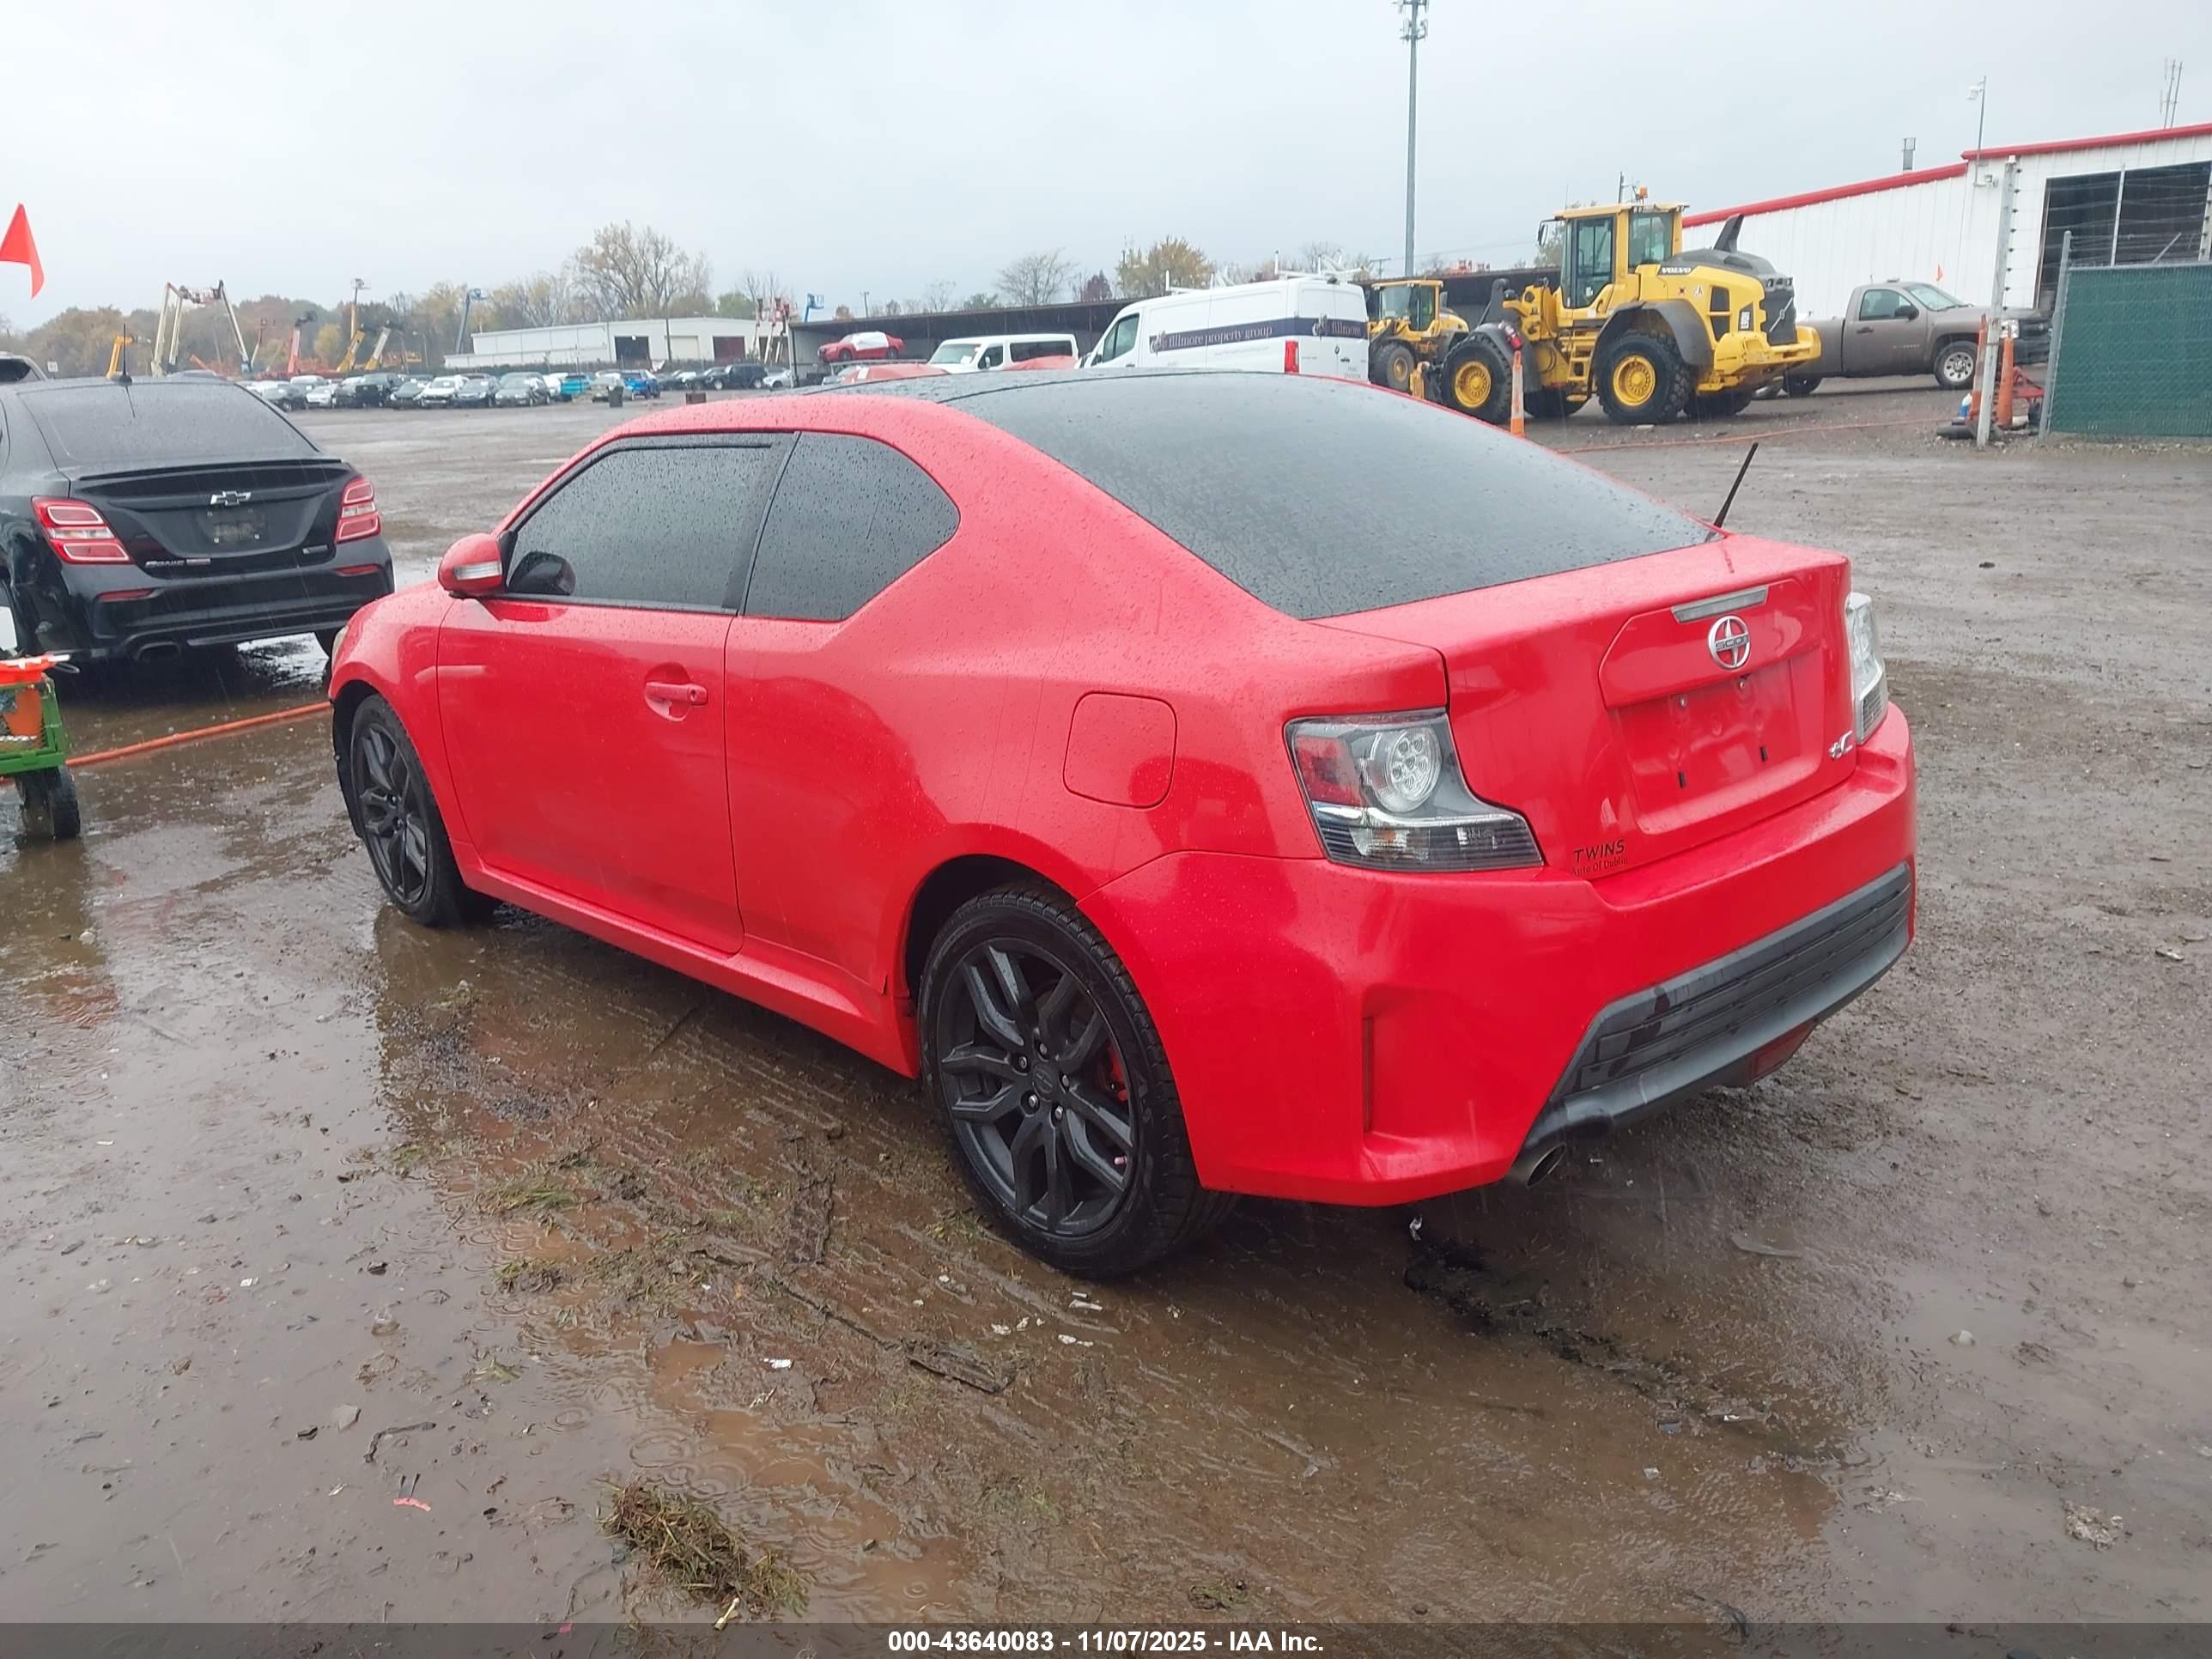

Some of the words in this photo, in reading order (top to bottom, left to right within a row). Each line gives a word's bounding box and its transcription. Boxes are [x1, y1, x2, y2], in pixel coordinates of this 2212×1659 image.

[1205, 328, 1243, 345] property
[1244, 326, 1273, 340] group
[1574, 839, 1625, 863] TWINS
[1604, 855, 1628, 869] Dublin
